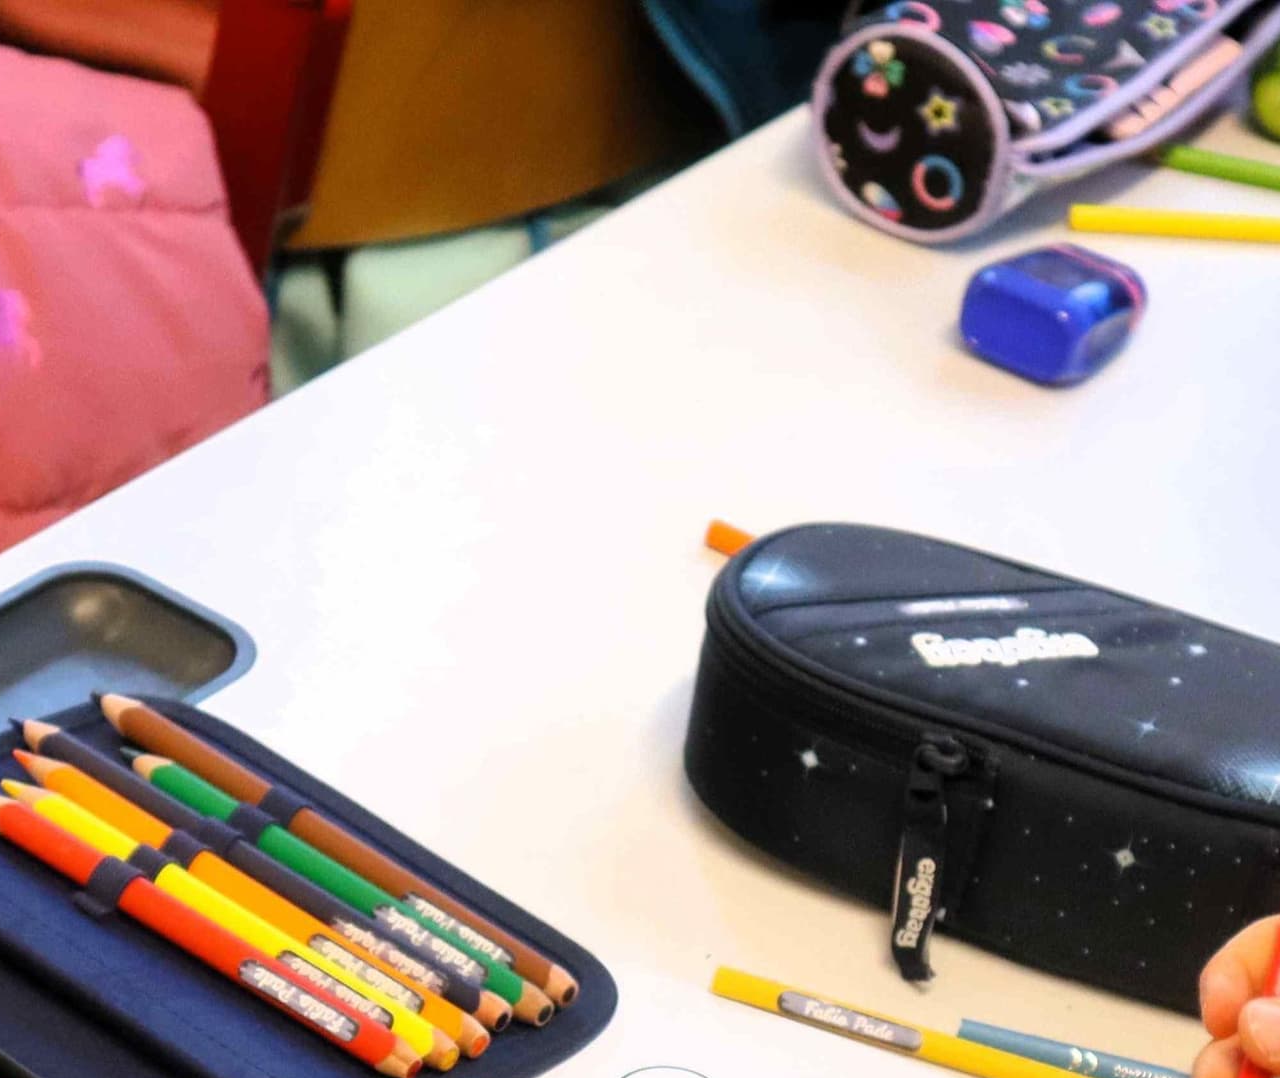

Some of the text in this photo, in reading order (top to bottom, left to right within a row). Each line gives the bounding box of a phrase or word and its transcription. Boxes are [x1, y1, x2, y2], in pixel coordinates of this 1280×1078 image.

[895, 857, 937, 949] ergobag
[253, 965, 346, 1034] Fabio Pade
[804, 1000, 895, 1041] Fabio Pade
